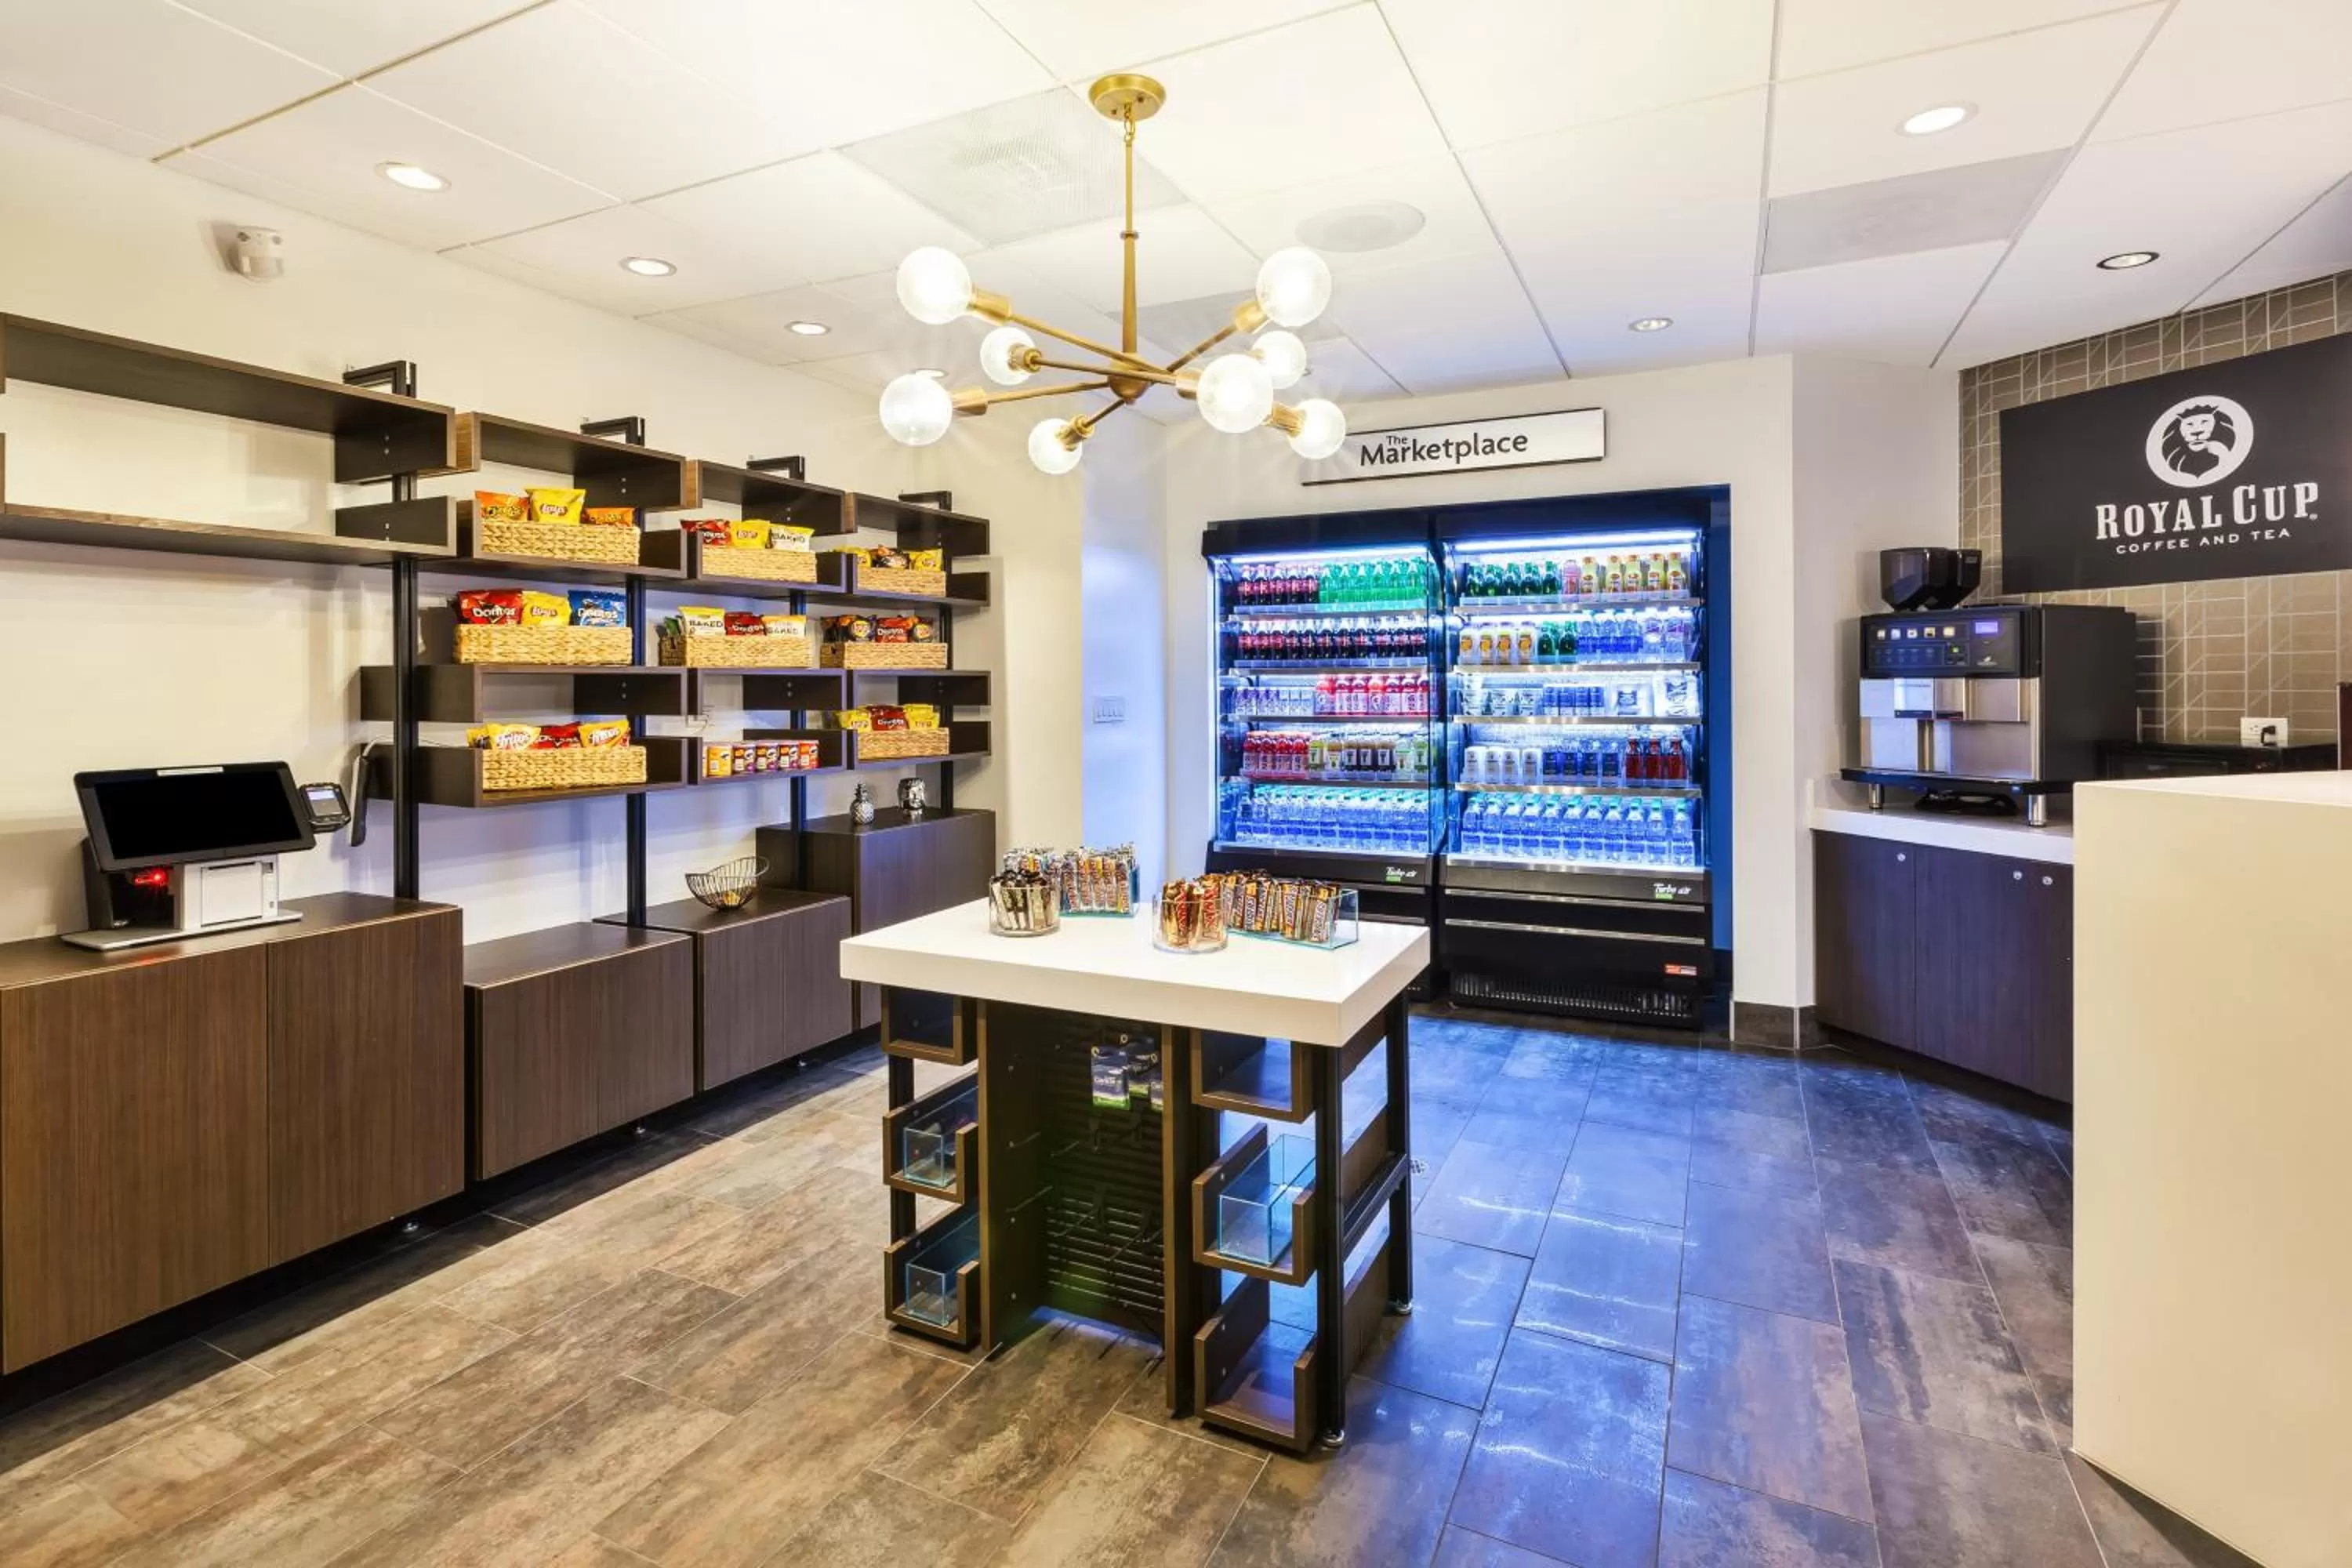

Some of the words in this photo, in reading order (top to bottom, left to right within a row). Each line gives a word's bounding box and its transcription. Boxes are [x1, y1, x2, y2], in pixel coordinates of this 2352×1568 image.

[1360, 432, 1528, 466] Marketplace
[1386, 435, 1408, 446] The
[2096, 495, 2223, 540] ROYAL
[2116, 538, 2189, 554] COFFEE
[2199, 534, 2240, 546] AND
[2251, 528, 2290, 540] TEA
